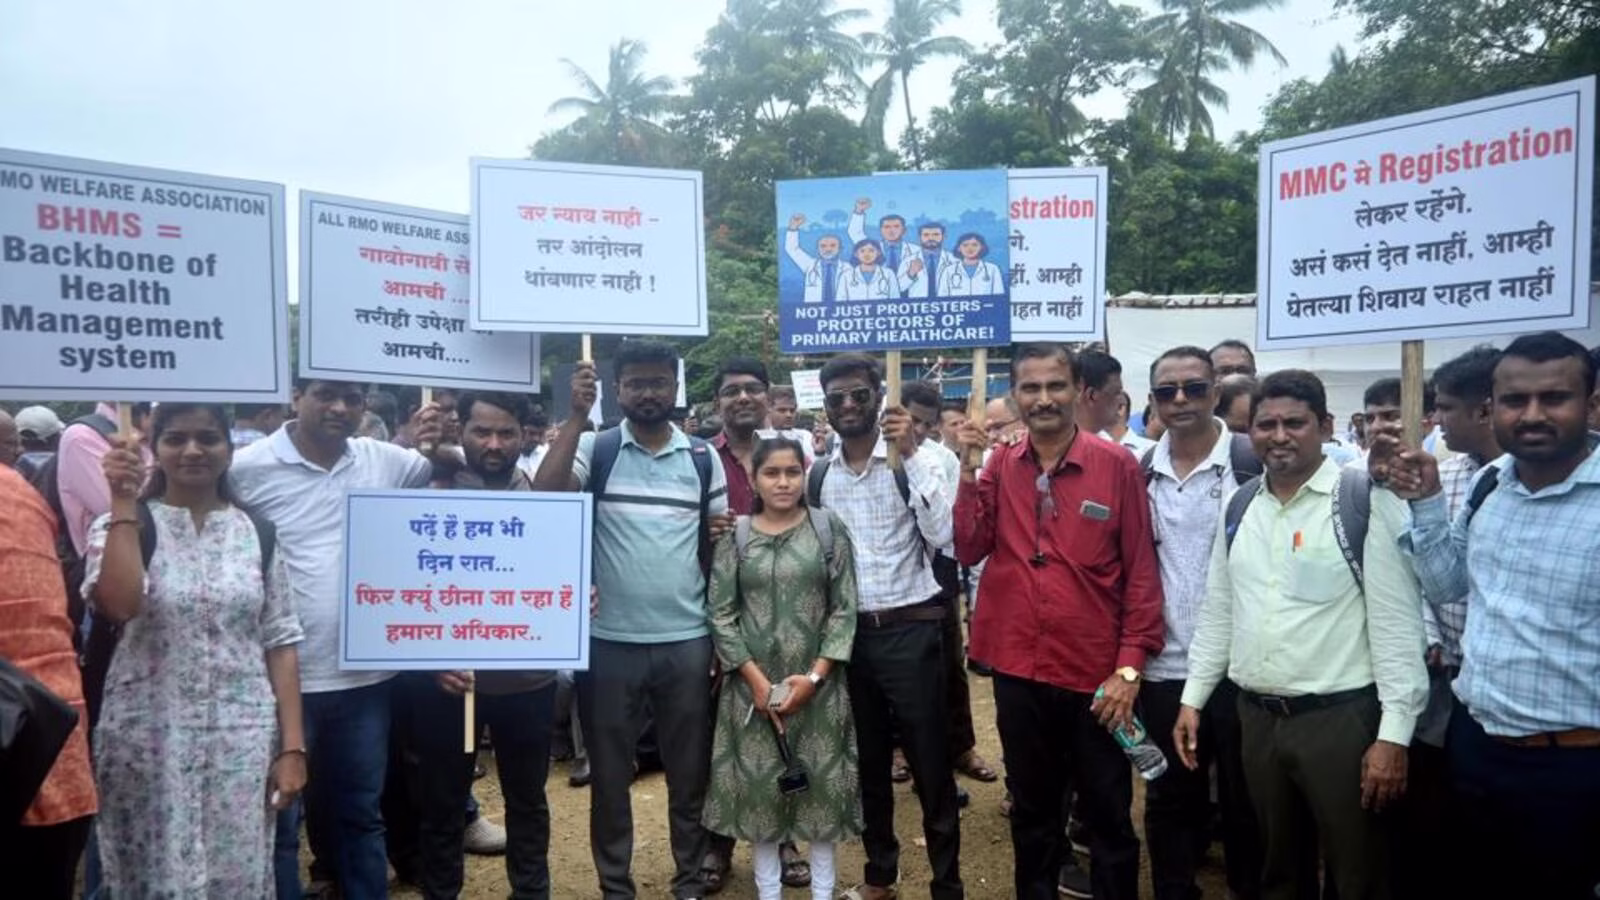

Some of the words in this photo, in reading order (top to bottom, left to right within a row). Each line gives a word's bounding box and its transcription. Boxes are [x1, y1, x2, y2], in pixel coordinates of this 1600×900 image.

[1277, 161, 1347, 200] MMC
[1378, 126, 1574, 185] Registration
[0, 169, 34, 190] MO
[40, 174, 135, 201] WELFARE
[142, 187, 266, 215] ASSOCIATION
[517, 206, 548, 222] जर
[551, 207, 597, 224] न्याय
[1010, 193, 1094, 220] stration
[1354, 200, 1409, 229] लेकर
[37, 203, 142, 239] BHMS
[318, 211, 344, 228] ALL
[348, 215, 379, 232] RMO
[382, 220, 442, 241] WELFARE
[445, 230, 470, 245] ASS
[537, 239, 564, 256] तर
[570, 235, 643, 260] आंदोलन
[1009, 229, 1030, 251] गे.
[1290, 248, 1327, 277] असं
[1332, 243, 1373, 273] कसं
[1377, 240, 1411, 272] देत
[1482, 219, 1556, 256] आम्ही
[2, 235, 174, 275] Backbone
[187, 253, 217, 277] of
[454, 254, 470, 274] से
[1009, 262, 1030, 288] हीं.
[1036, 262, 1083, 287] आम्ही
[59, 274, 171, 306] Health
[383, 279, 447, 300] आमची
[1285, 291, 1353, 319] घेतल्या
[1358, 284, 1428, 313] शिवाय
[1432, 280, 1493, 308] राहत
[1498, 266, 1556, 302] नाहीं
[354, 305, 411, 330] तरीही
[415, 310, 465, 334] उपेक्षा
[795, 306, 828, 319] NOT
[832, 303, 873, 318] JUST
[1010, 301, 1042, 320] ाहत
[1046, 295, 1083, 320] नाहीं
[1, 305, 225, 341] Management
[791, 330, 872, 346] PRIMARY
[877, 326, 995, 344] HEALTHCARE!
[817, 314, 936, 332] PROTECTORS
[941, 313, 966, 327] OF
[59, 344, 177, 373] system
[463, 521, 495, 541] हम
[499, 516, 525, 538] भी
[417, 549, 455, 575] दिन
[355, 583, 396, 607] फिर
[400, 583, 438, 614] क्यूं
[439, 584, 485, 607] छीना
[489, 590, 515, 607] जा
[520, 590, 554, 610] रहा
[385, 623, 444, 645] हमारा
